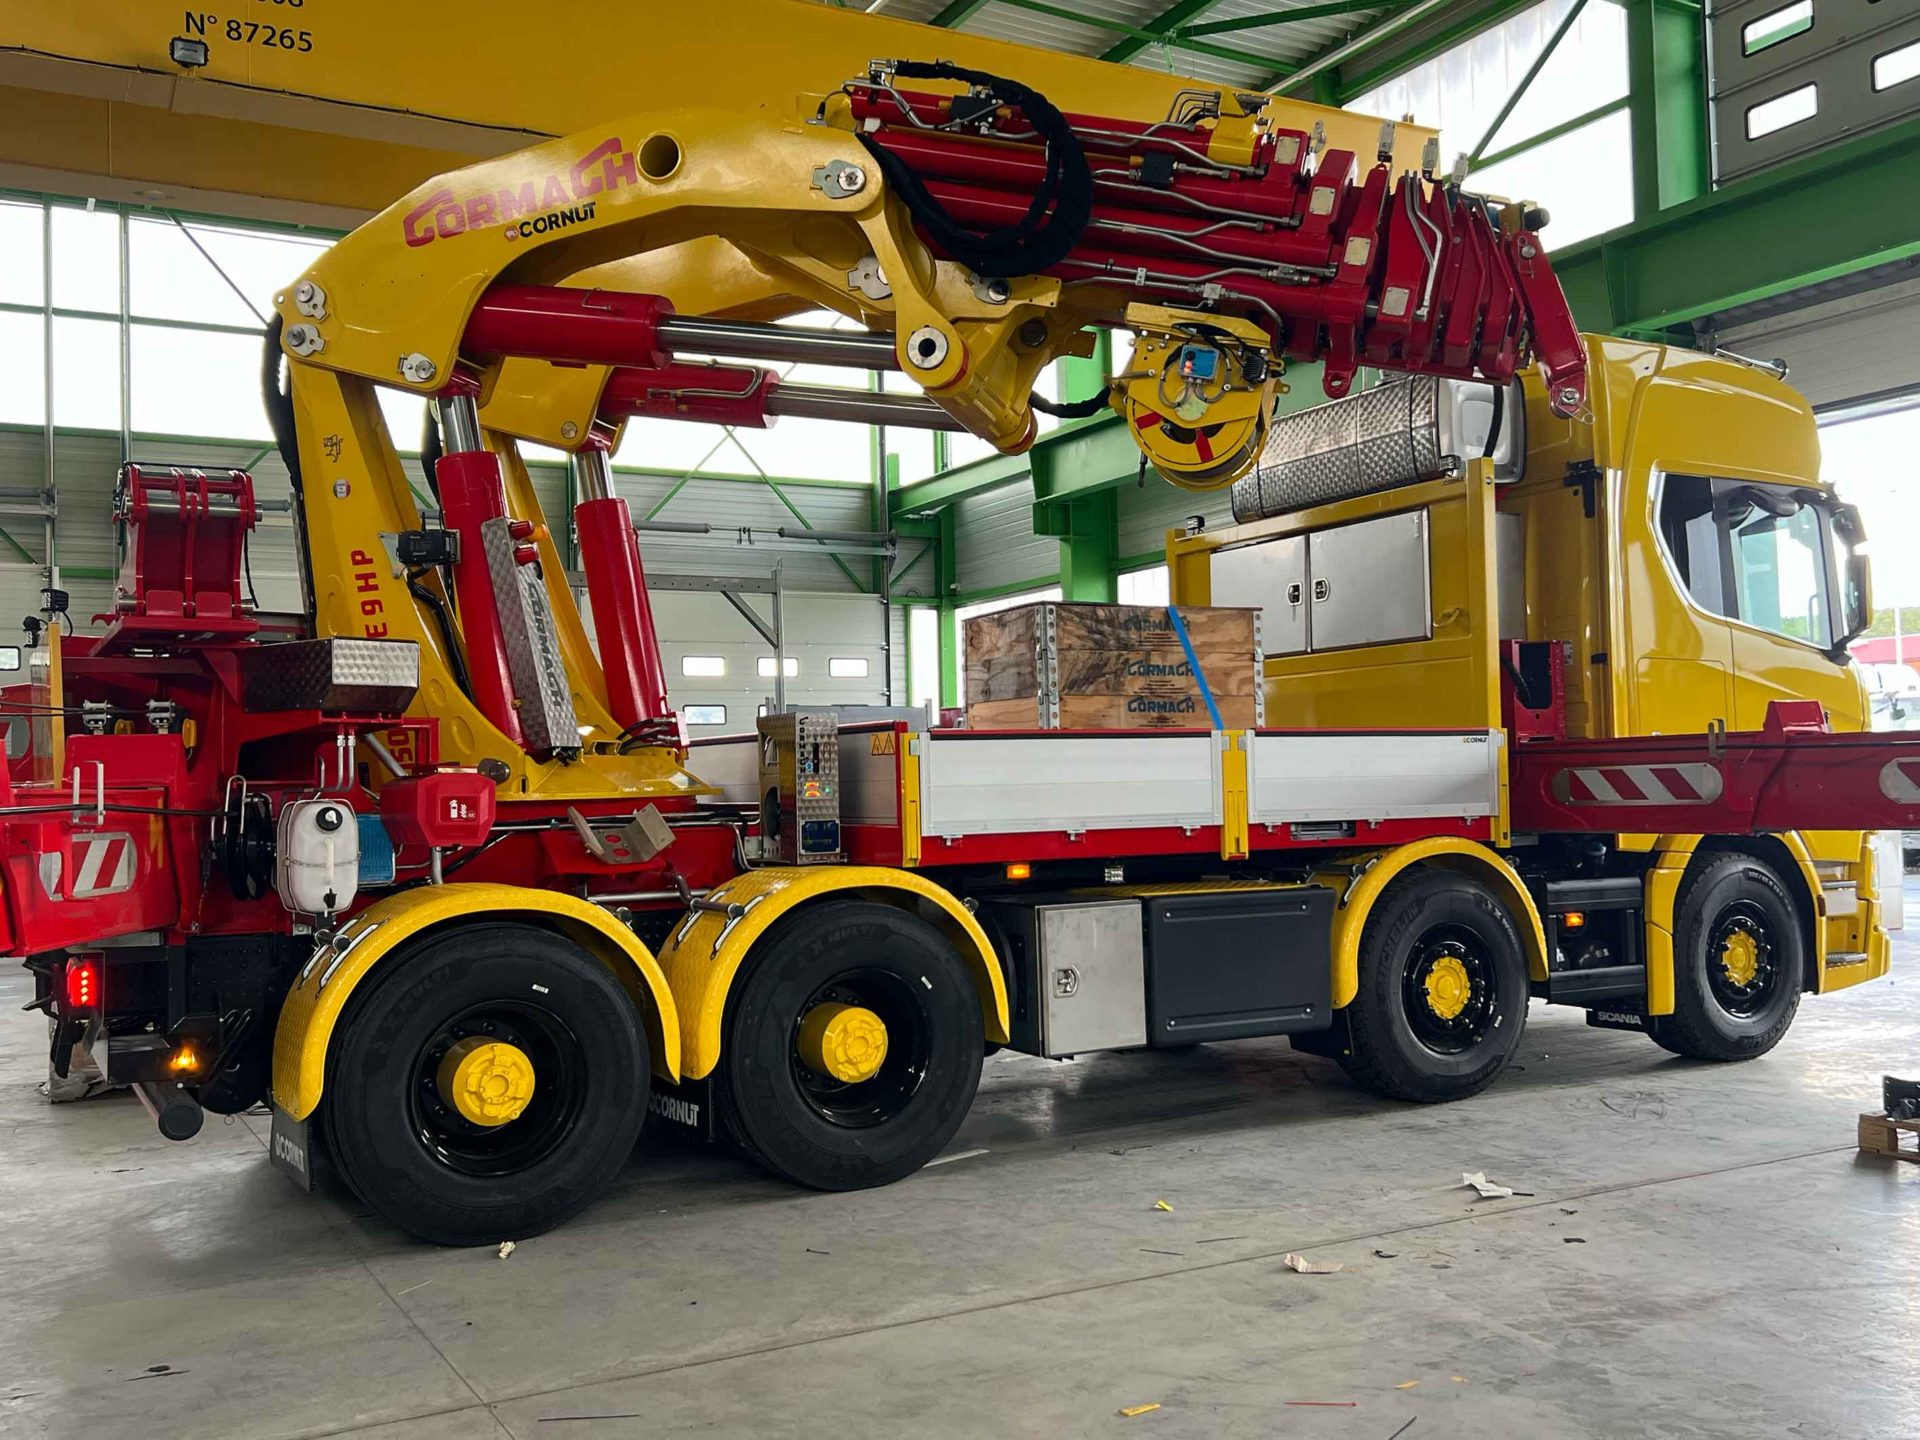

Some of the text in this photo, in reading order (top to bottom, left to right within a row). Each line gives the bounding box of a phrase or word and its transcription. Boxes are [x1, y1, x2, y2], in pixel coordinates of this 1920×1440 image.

[185, 11, 313, 52] N° 87265
[403, 137, 638, 248] CORMACH
[518, 202, 596, 238] CORNUT
[527, 582, 565, 708] CORMACH
[1127, 660, 1195, 677] CORMACH
[1127, 696, 1196, 713] CORMACH
[1597, 1010, 1642, 1025] SCANIA
[655, 1093, 700, 1126] CORNUT
